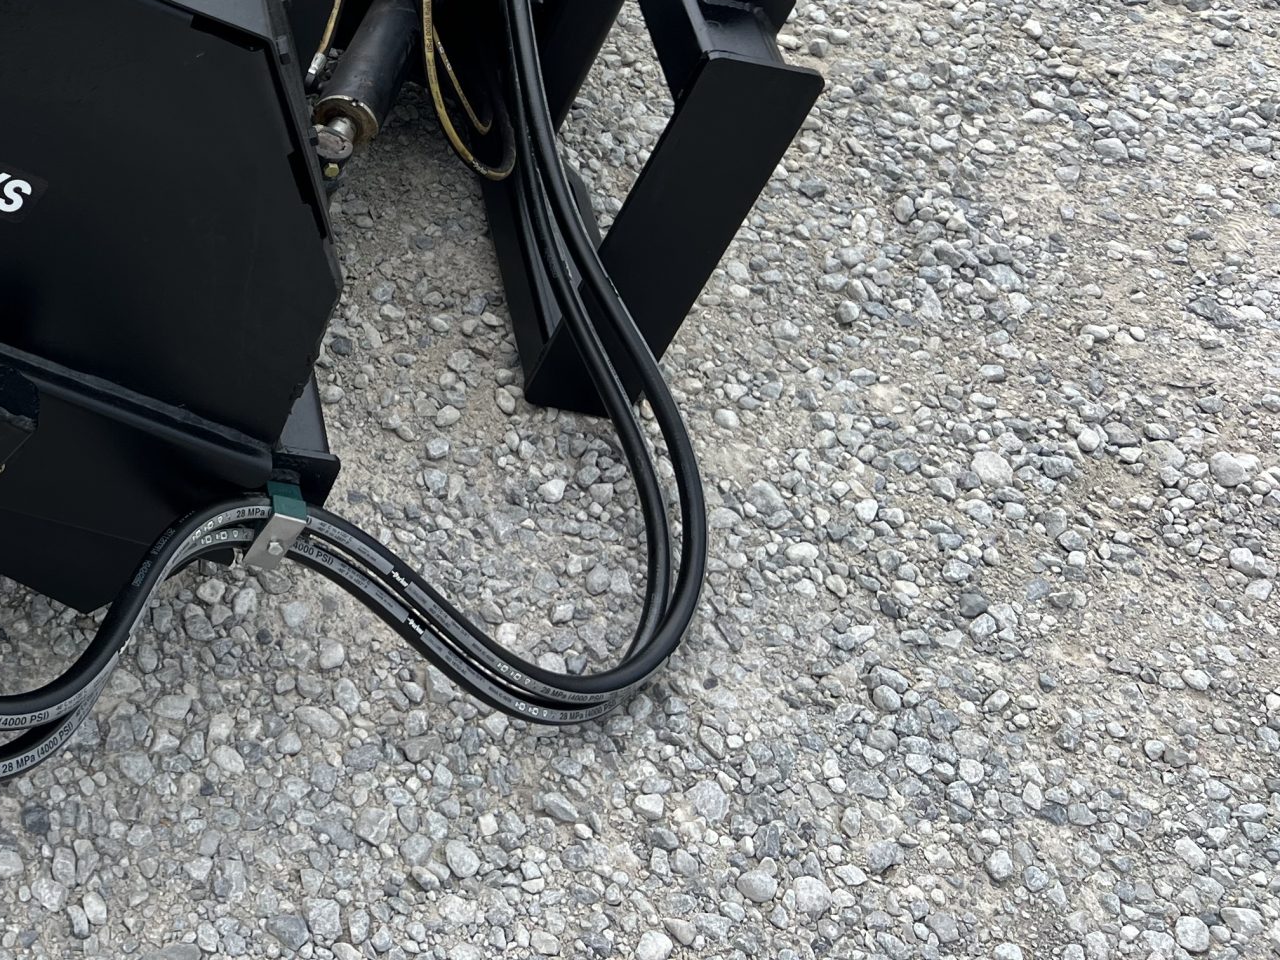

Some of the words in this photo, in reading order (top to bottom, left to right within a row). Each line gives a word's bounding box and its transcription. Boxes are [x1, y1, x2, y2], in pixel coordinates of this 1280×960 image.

[237, 510, 245, 518] 28
[248, 508, 265, 517] MPa
[293, 541, 314, 555] 4000
[316, 551, 334, 565] PSI)
[551, 690, 567, 699] MPa
[568, 693, 588, 701] (4000
[30, 711, 49, 723] PSI)
[560, 712, 568, 720] 28
[569, 711, 584, 720] MPa
[2, 762, 13, 774] 28
[16, 754, 36, 769] MPa
[37, 738, 58, 758] (4000
[58, 721, 73, 741] PSI)
